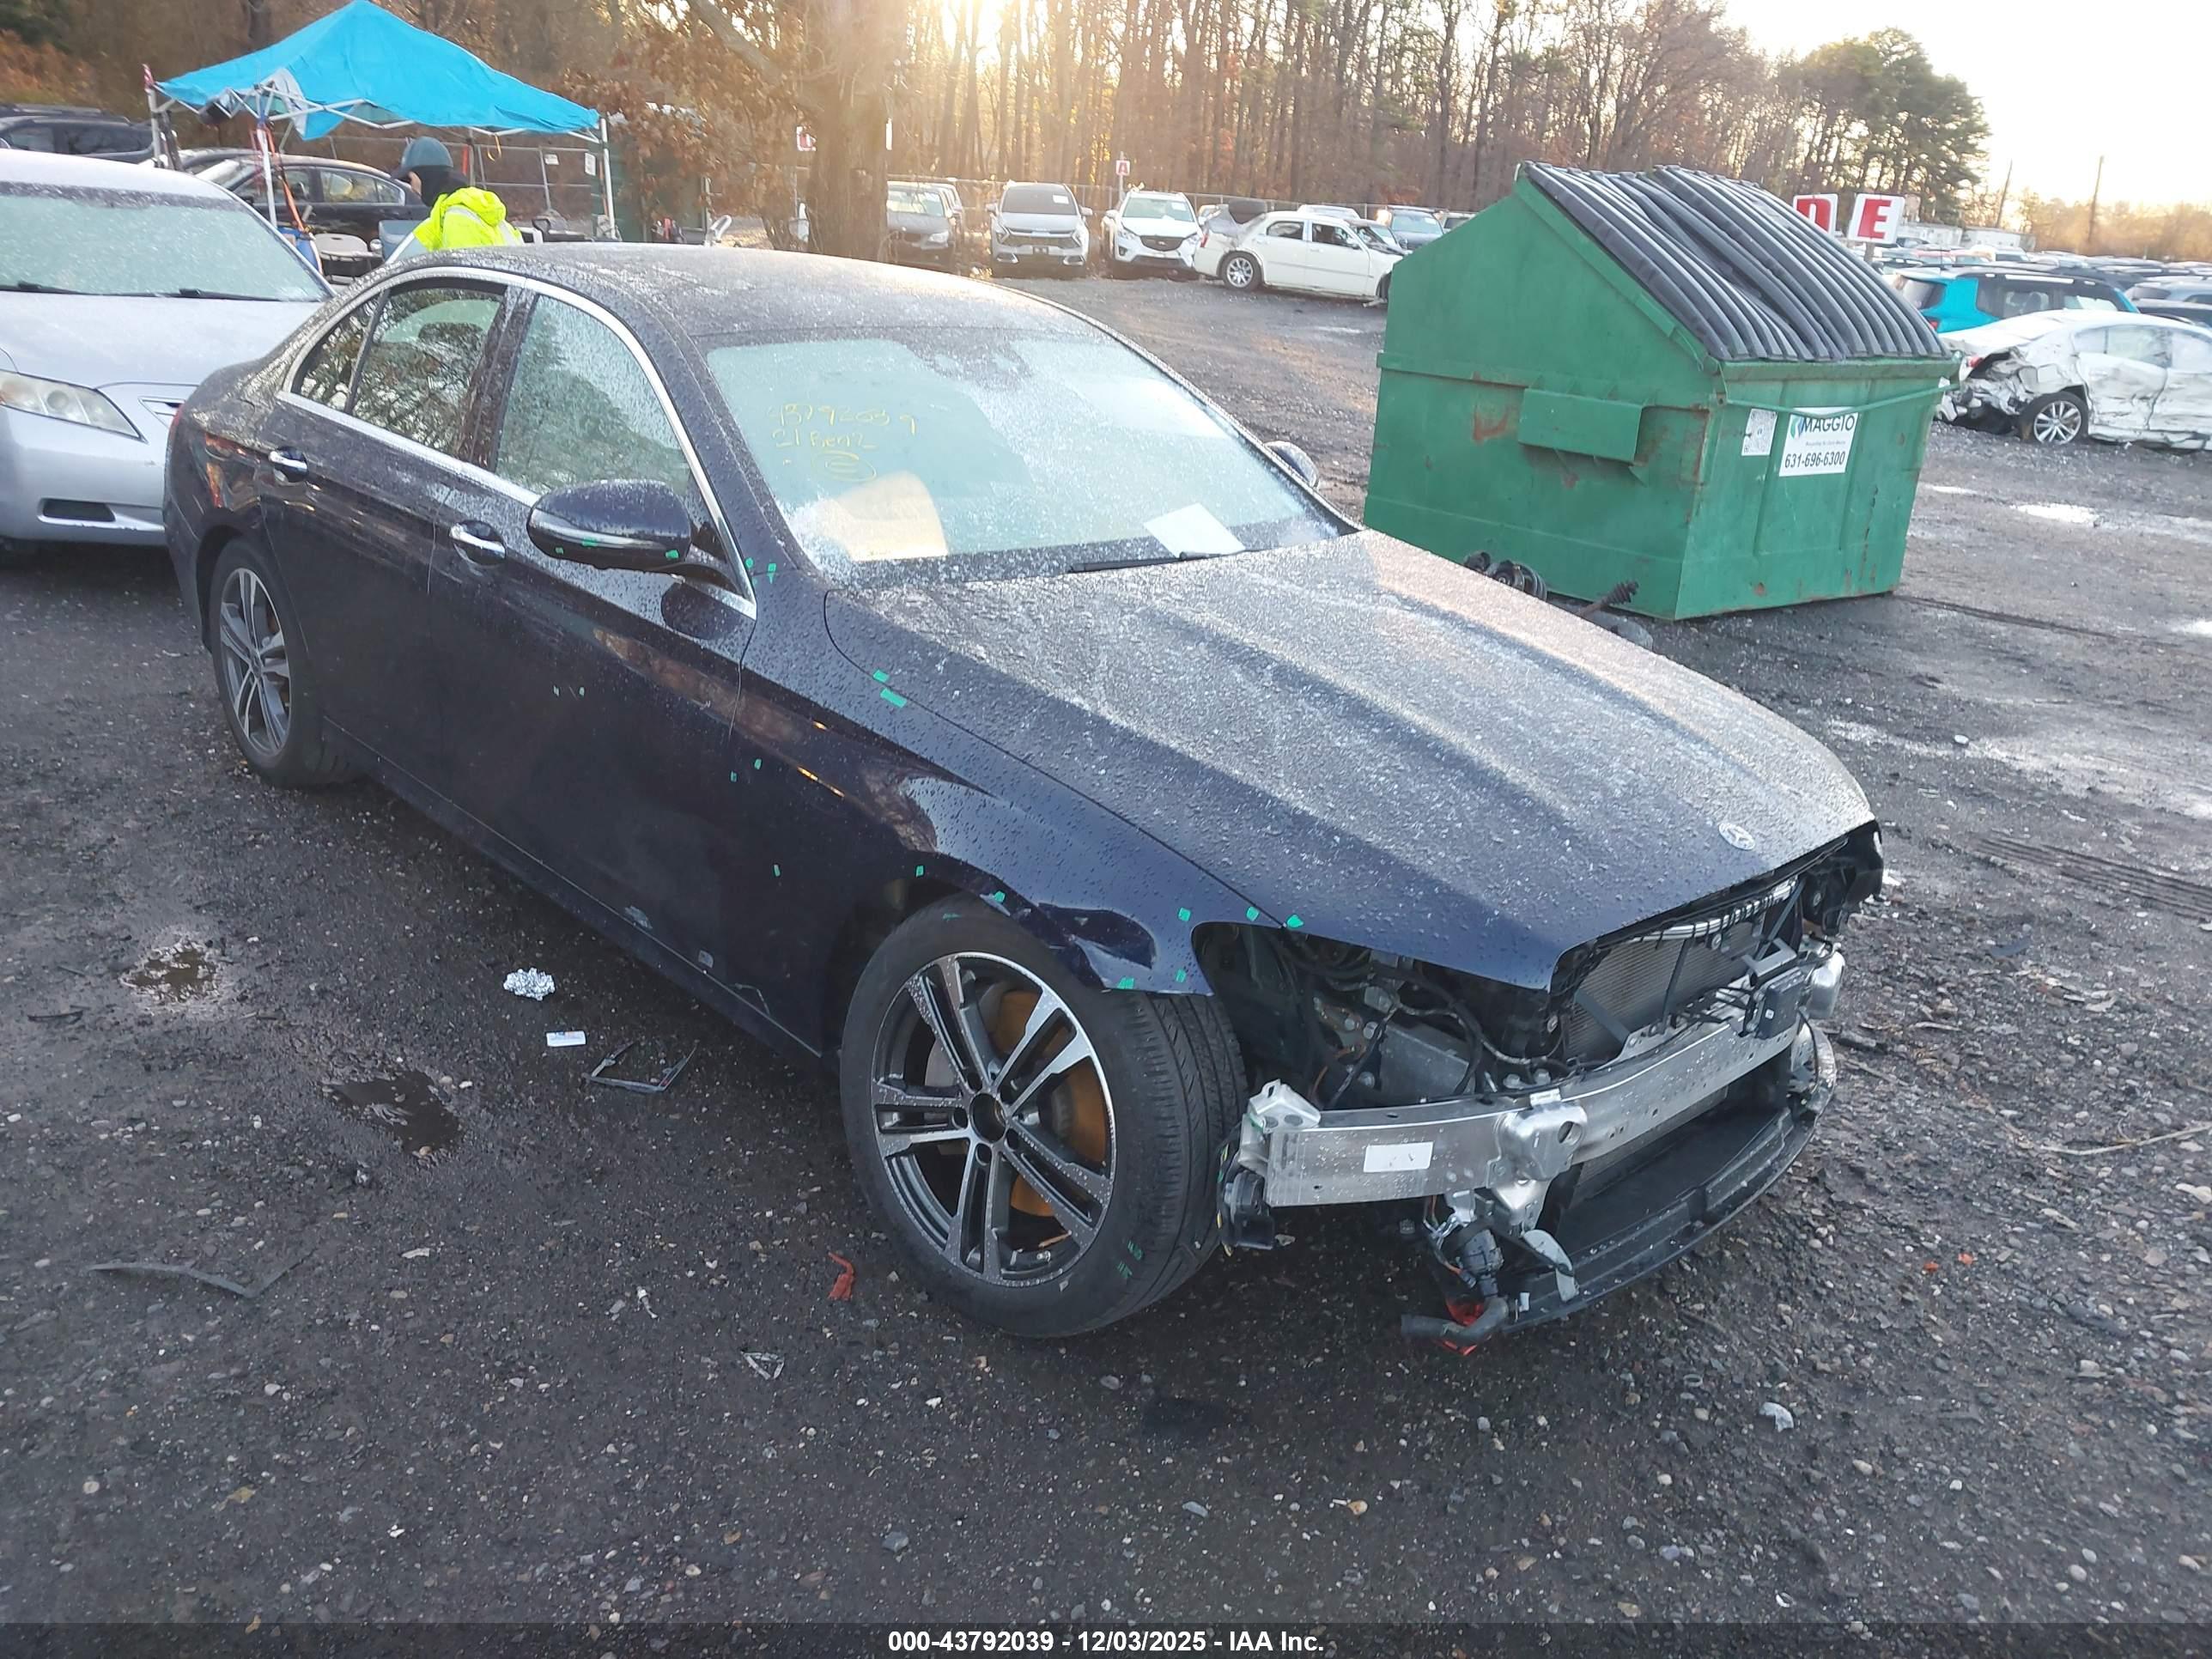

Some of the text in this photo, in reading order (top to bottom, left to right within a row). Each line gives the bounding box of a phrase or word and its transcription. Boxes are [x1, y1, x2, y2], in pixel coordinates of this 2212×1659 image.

[1857, 198, 1893, 240] E
[1801, 414, 1855, 433] MAGGIO
[1784, 450, 1845, 469] 631-696-6300
